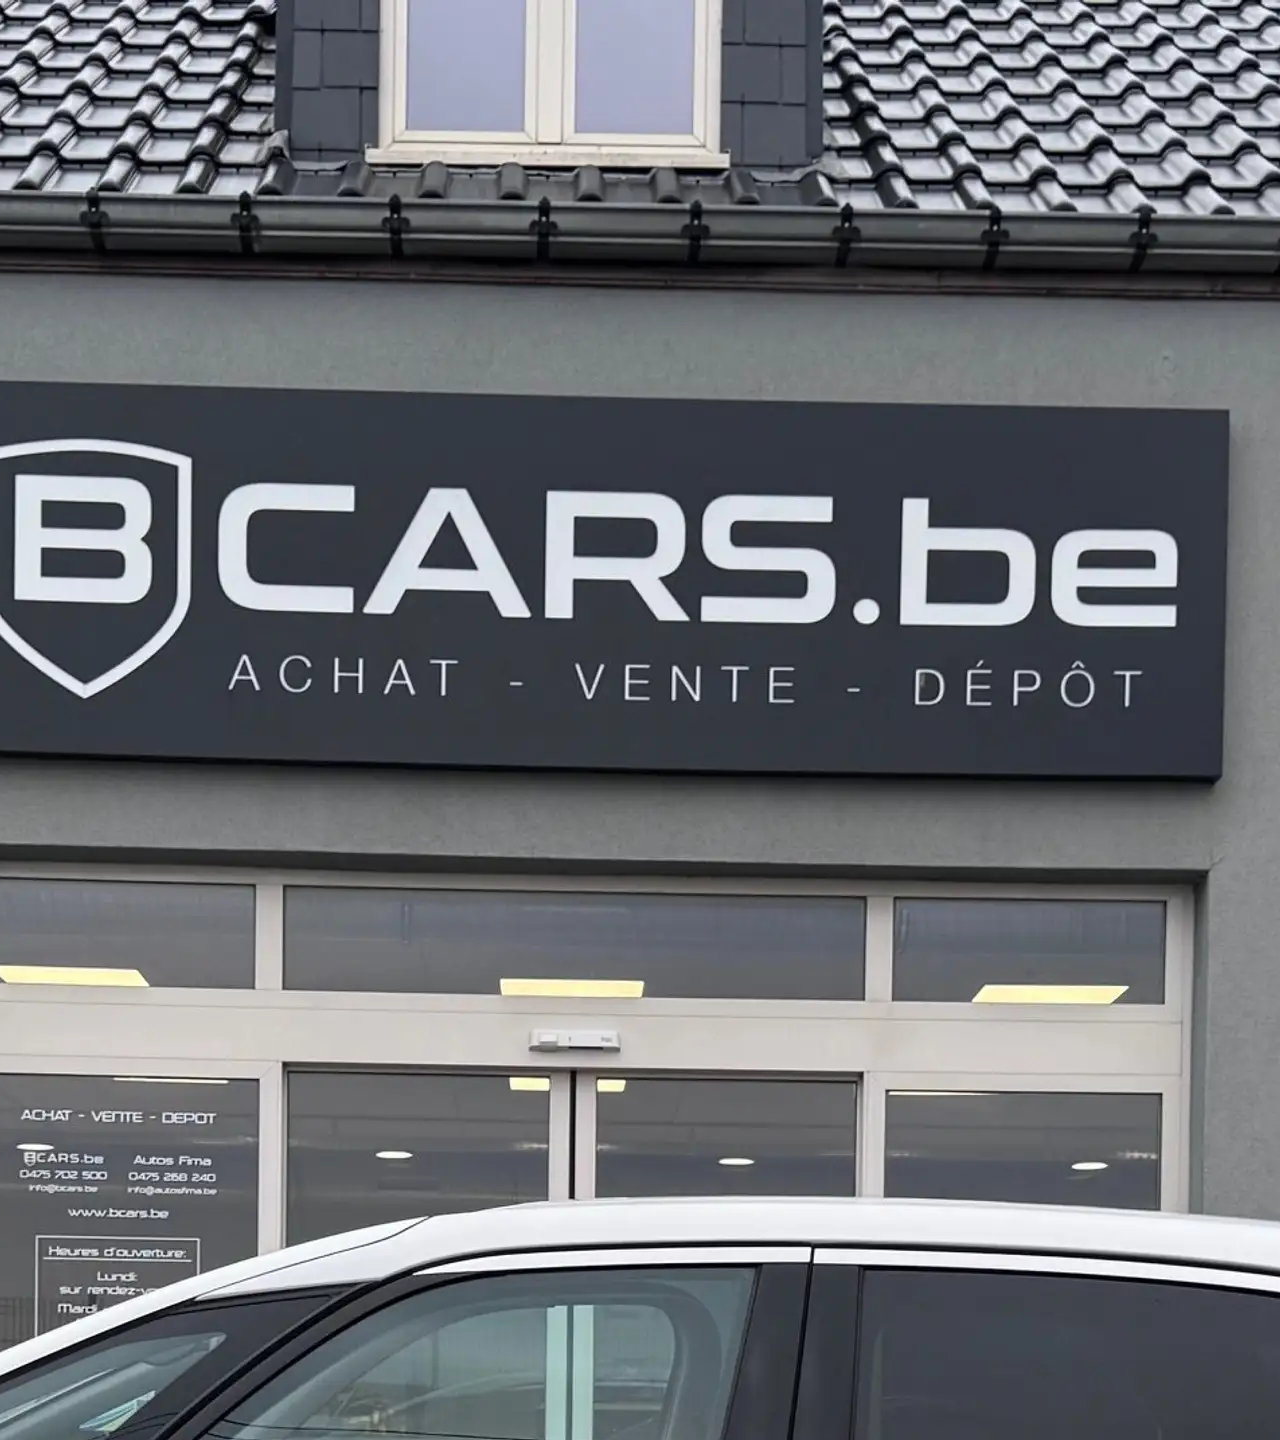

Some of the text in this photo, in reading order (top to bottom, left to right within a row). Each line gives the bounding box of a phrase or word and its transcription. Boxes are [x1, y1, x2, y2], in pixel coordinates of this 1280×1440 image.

[228, 653, 460, 697] ACHAT
[575, 663, 797, 704] VENTE
[914, 658, 1143, 708] DÉPÔT
[21, 1109, 73, 1122] ACHAT
[90, 1110, 144, 1123] VENTE
[162, 1111, 217, 1125] DEPOT
[133, 1154, 212, 1166] Autos Fima
[19, 1169, 108, 1181] 0475 702 500
[128, 1171, 160, 1182] 0475
[191, 1173, 217, 1184] 240
[28, 1183, 99, 1195] info@bcars.be
[127, 1185, 218, 1197] info@autosfima.be
[67, 1207, 170, 1219] www.bcars.be
[48, 1245, 100, 1257] Heures
[58, 1285, 83, 1295] sur
